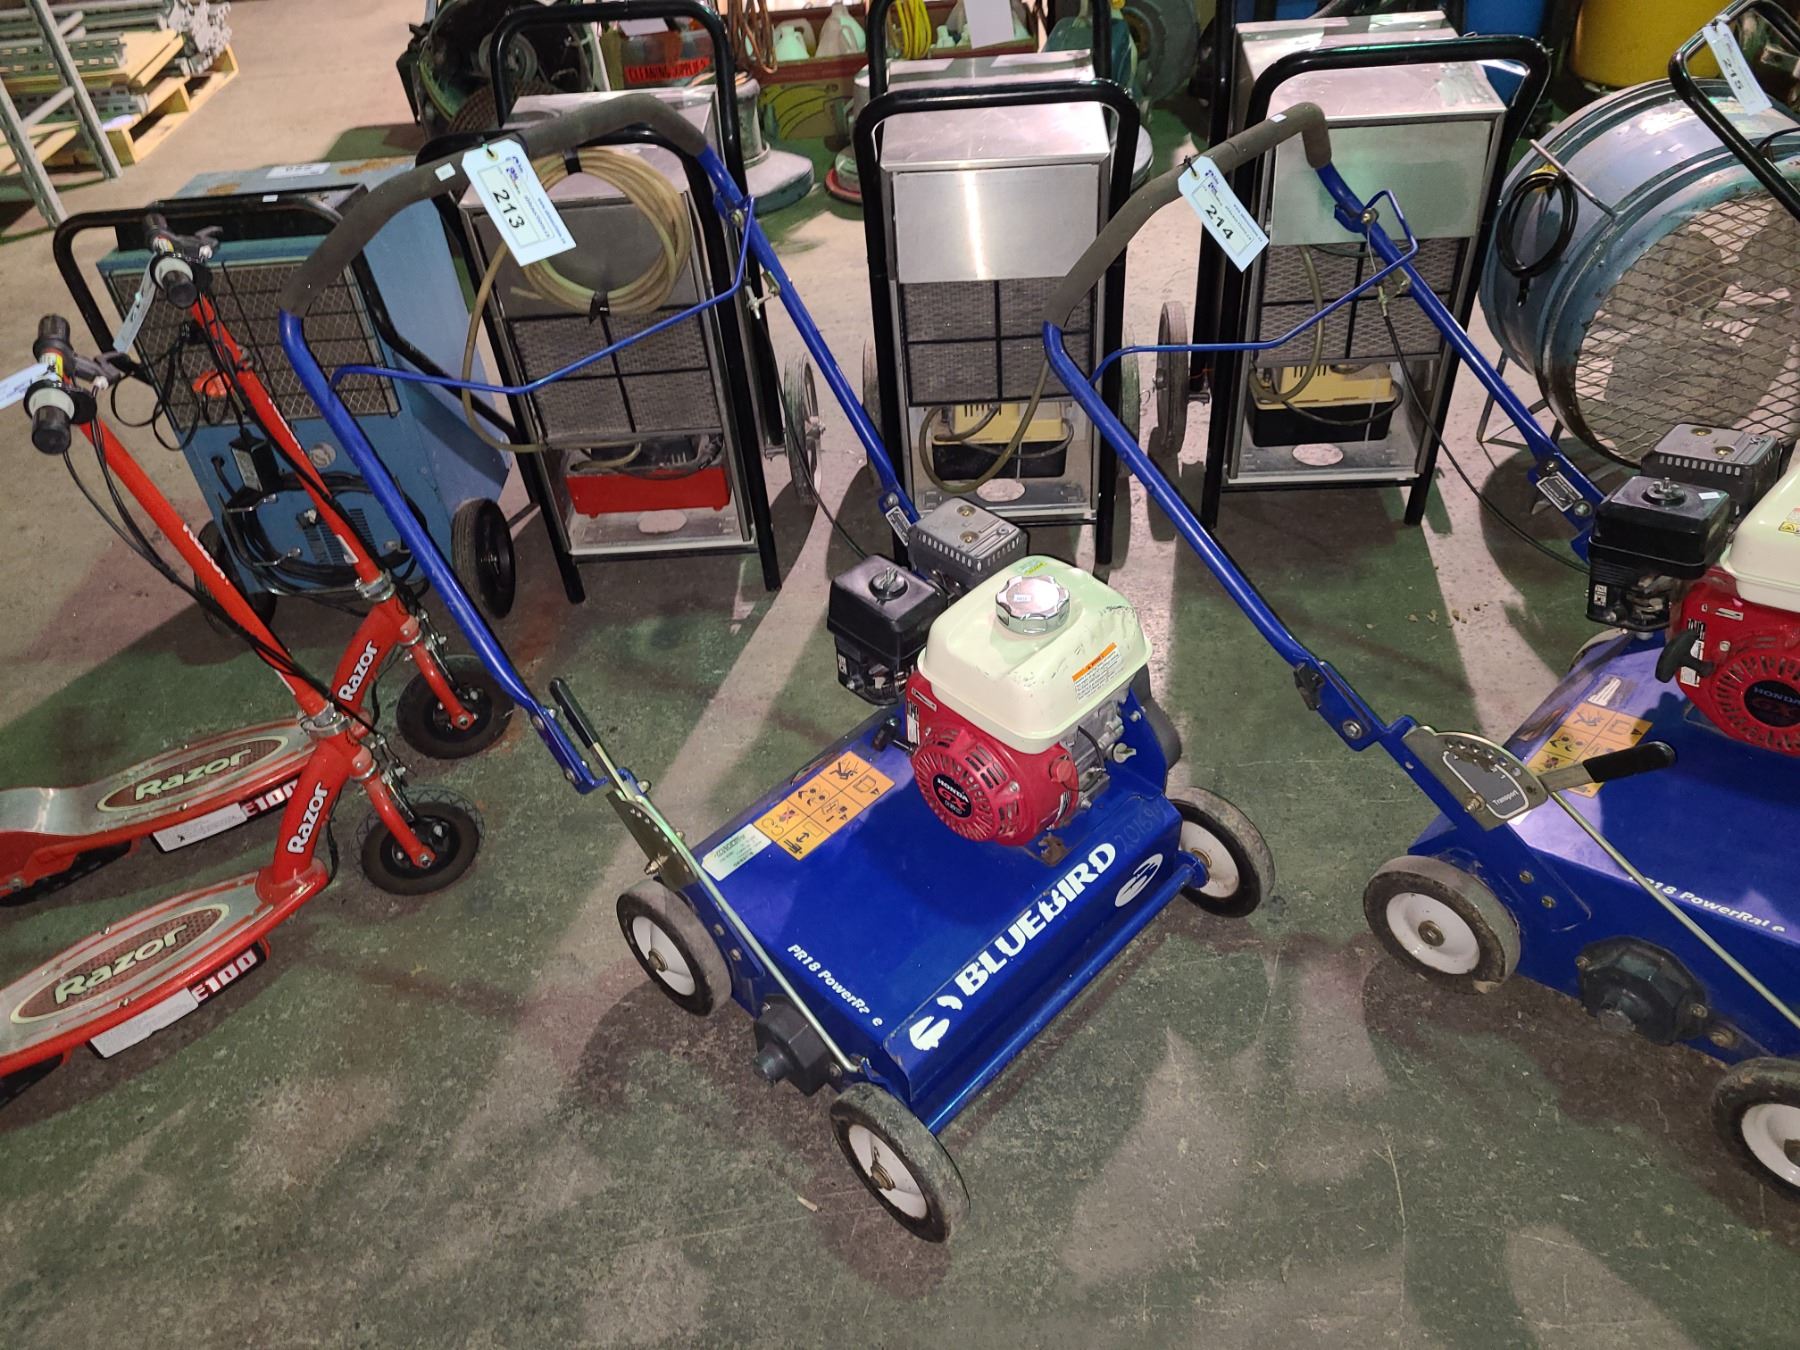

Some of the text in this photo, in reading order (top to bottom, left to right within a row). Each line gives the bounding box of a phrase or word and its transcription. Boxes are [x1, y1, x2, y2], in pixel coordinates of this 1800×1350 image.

[492, 188, 526, 229] 213
[1205, 204, 1234, 240] 214
[337, 640, 379, 701] Razor
[135, 748, 252, 801] Razor
[937, 778, 970, 803] HONDA
[937, 787, 967, 811] GX
[287, 781, 328, 853] Razor
[955, 843, 1116, 996] BLUEBIRD
[54, 923, 188, 1004] Razor
[191, 949, 258, 1003] E100
[787, 944, 883, 1026] PR18 PowerRae
